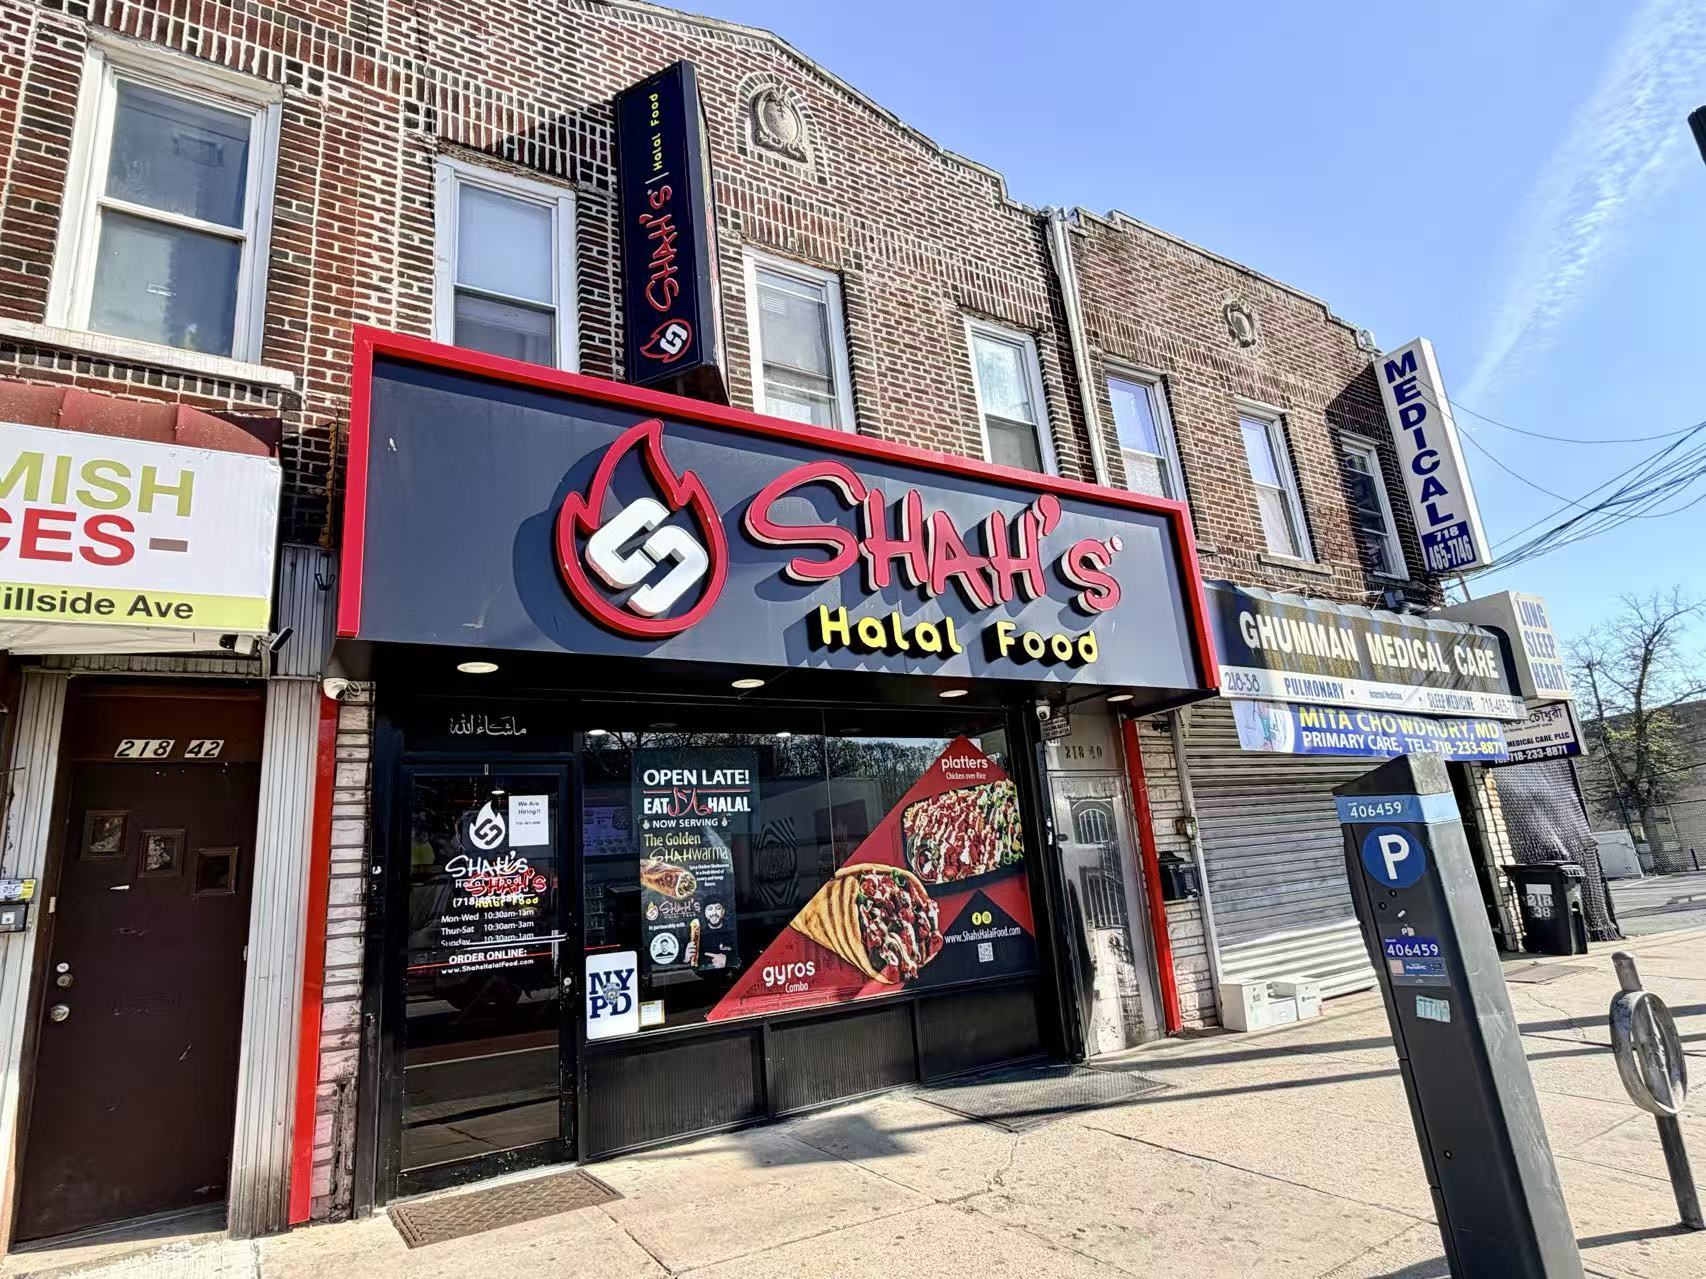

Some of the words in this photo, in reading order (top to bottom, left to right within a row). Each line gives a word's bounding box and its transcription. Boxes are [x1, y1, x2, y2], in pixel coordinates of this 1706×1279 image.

[650, 93, 659, 127] Food
[652, 133, 662, 171] Halal
[1383, 350, 1454, 527] MEDICAL
[1434, 526, 1459, 541] 718
[1428, 535, 1473, 570] 465-7746
[0, 586, 115, 616] illside
[127, 594, 194, 619] Ave
[1516, 600, 1548, 628] LUNG
[820, 604, 963, 654] Halal
[997, 620, 1099, 663] Food
[1239, 610, 1360, 662] GHUMMAN
[1365, 632, 1450, 673] MEDICAL
[1454, 645, 1500, 679] CARE
[1523, 630, 1556, 659] SLEEP
[1530, 662, 1568, 690] HEART
[1224, 671, 1260, 693] 218-38
[1284, 677, 1346, 699] PULMONARY
[1427, 692, 1446, 709] SLEEP
[1446, 693, 1475, 711] MEDICINE
[1300, 706, 1353, 730] MITA
[1357, 711, 1474, 740] CHOWDHURY,
[1475, 720, 1500, 739] MD
[117, 741, 170, 757] 218
[186, 741, 221, 757] 42
[1302, 731, 1365, 750] PRIMARY
[1368, 735, 1403, 753] CARE,
[1507, 738, 1535, 747] MEDICAL
[1554, 732, 1570, 740] PLLC
[941, 755, 988, 772] platters
[1510, 745, 1567, 762] 718-233-8871
[643, 769, 697, 785] OPEN
[702, 768, 750, 785] LATE!
[643, 797, 669, 814] EAT
[708, 796, 751, 813] HALAL
[1350, 801, 1402, 818] 406459
[652, 819, 677, 828] NOW
[679, 818, 718, 828] SERVING
[644, 833, 663, 846] The
[665, 832, 700, 846] Golden
[1378, 833, 1410, 880] P
[441, 913, 479, 924] Mon-Wed
[484, 909, 535, 920] 10:30am-1am
[441, 926, 474, 935] Thur-Sat
[484, 921, 535, 931] 10:30am-3am
[944, 926, 1021, 944] www.ShahsHalalFood.com
[449, 952, 485, 965] ORDER
[487, 948, 527, 960] ONLINE:
[1387, 944, 1439, 956] 406459
[589, 968, 635, 996] NY
[762, 960, 816, 987] gyros
[785, 982, 808, 993] Combo
[589, 992, 632, 1019] PD
